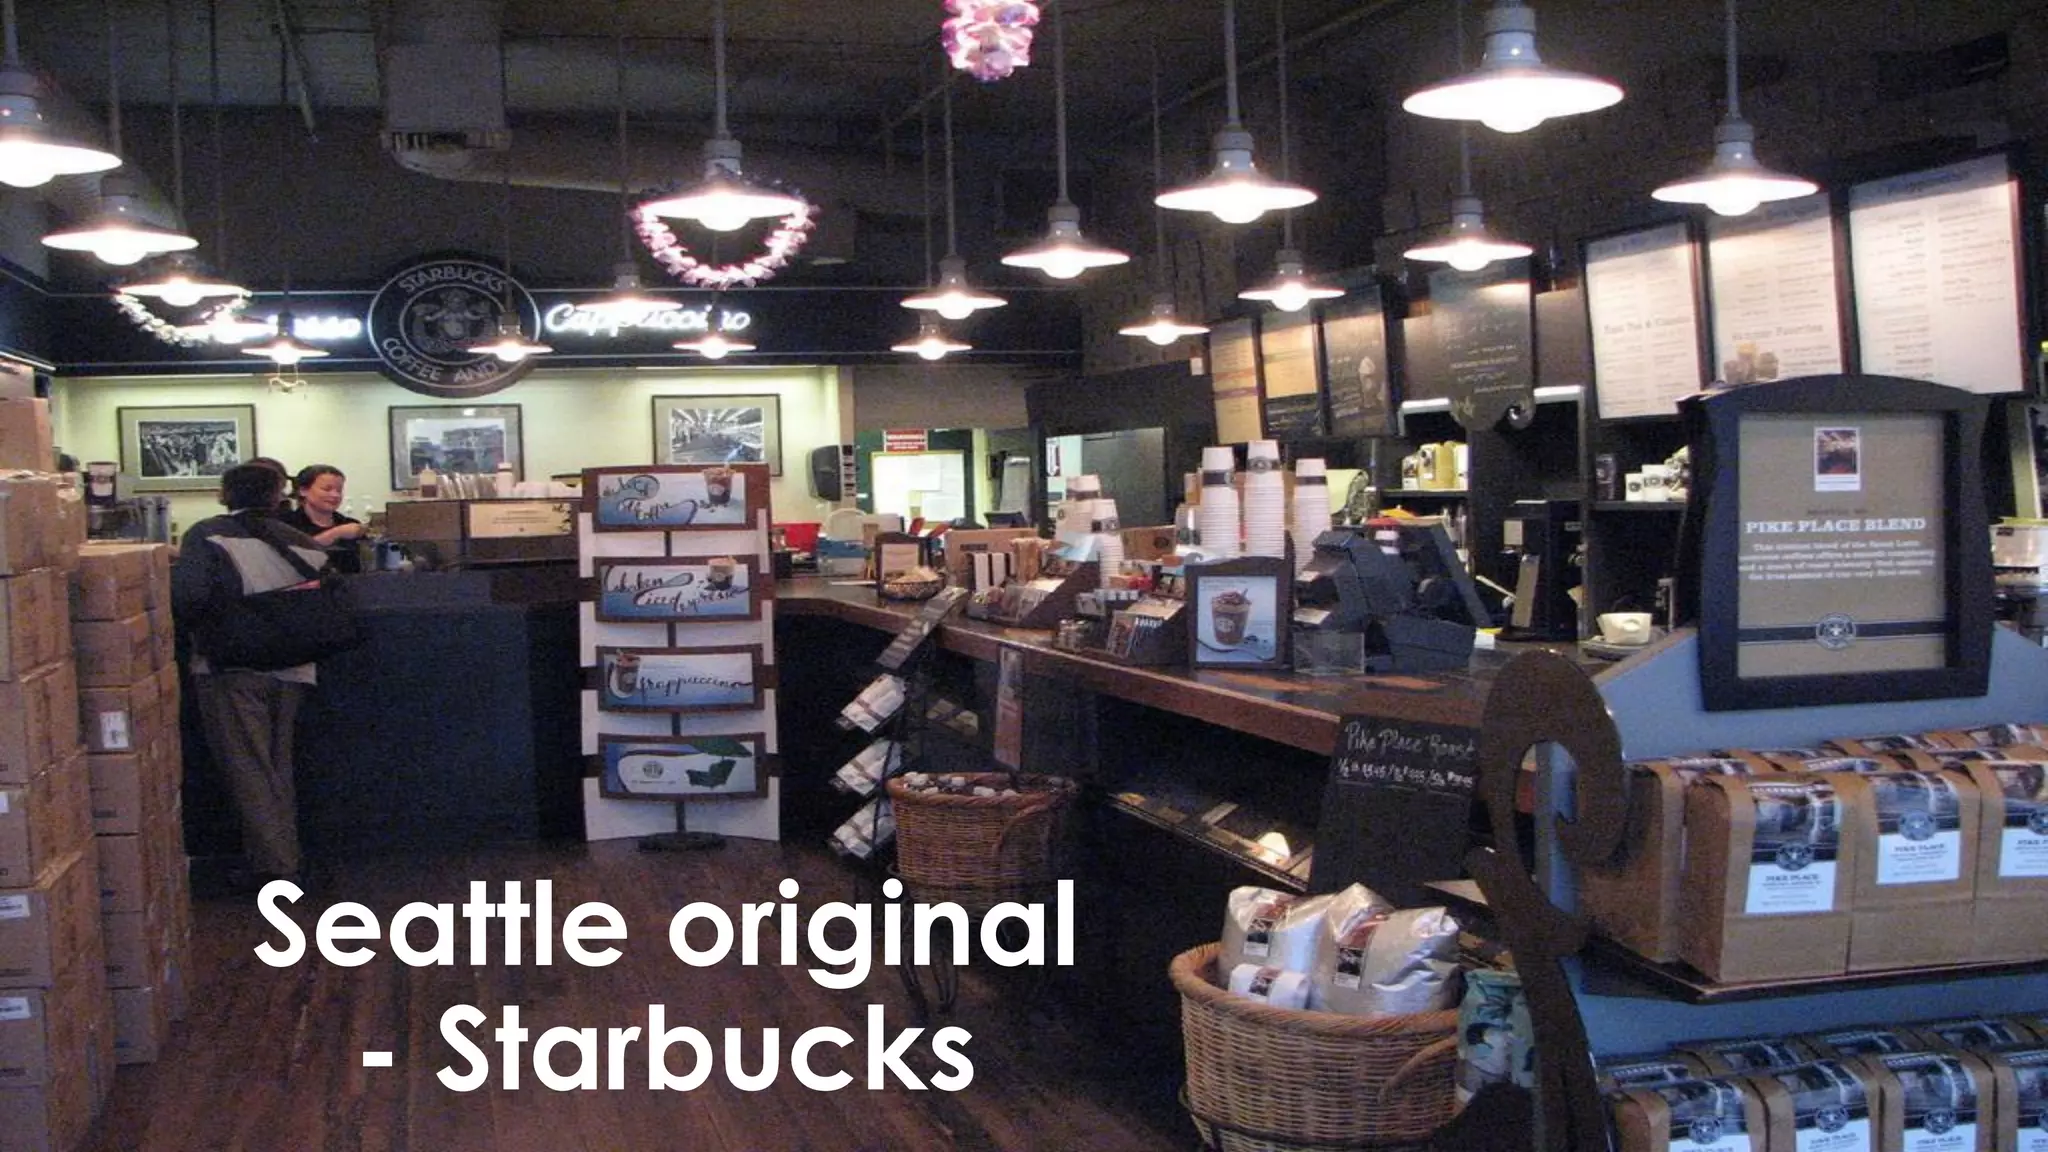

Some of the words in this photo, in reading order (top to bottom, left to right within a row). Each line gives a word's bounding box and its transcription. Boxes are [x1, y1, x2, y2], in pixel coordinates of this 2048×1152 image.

[399, 265, 507, 294] STARBUCKS
[382, 337, 443, 382] COFFEE
[1744, 521, 1793, 534] PIKE
[1797, 518, 1861, 533] PLACE
[1863, 517, 1927, 532] BLEND
